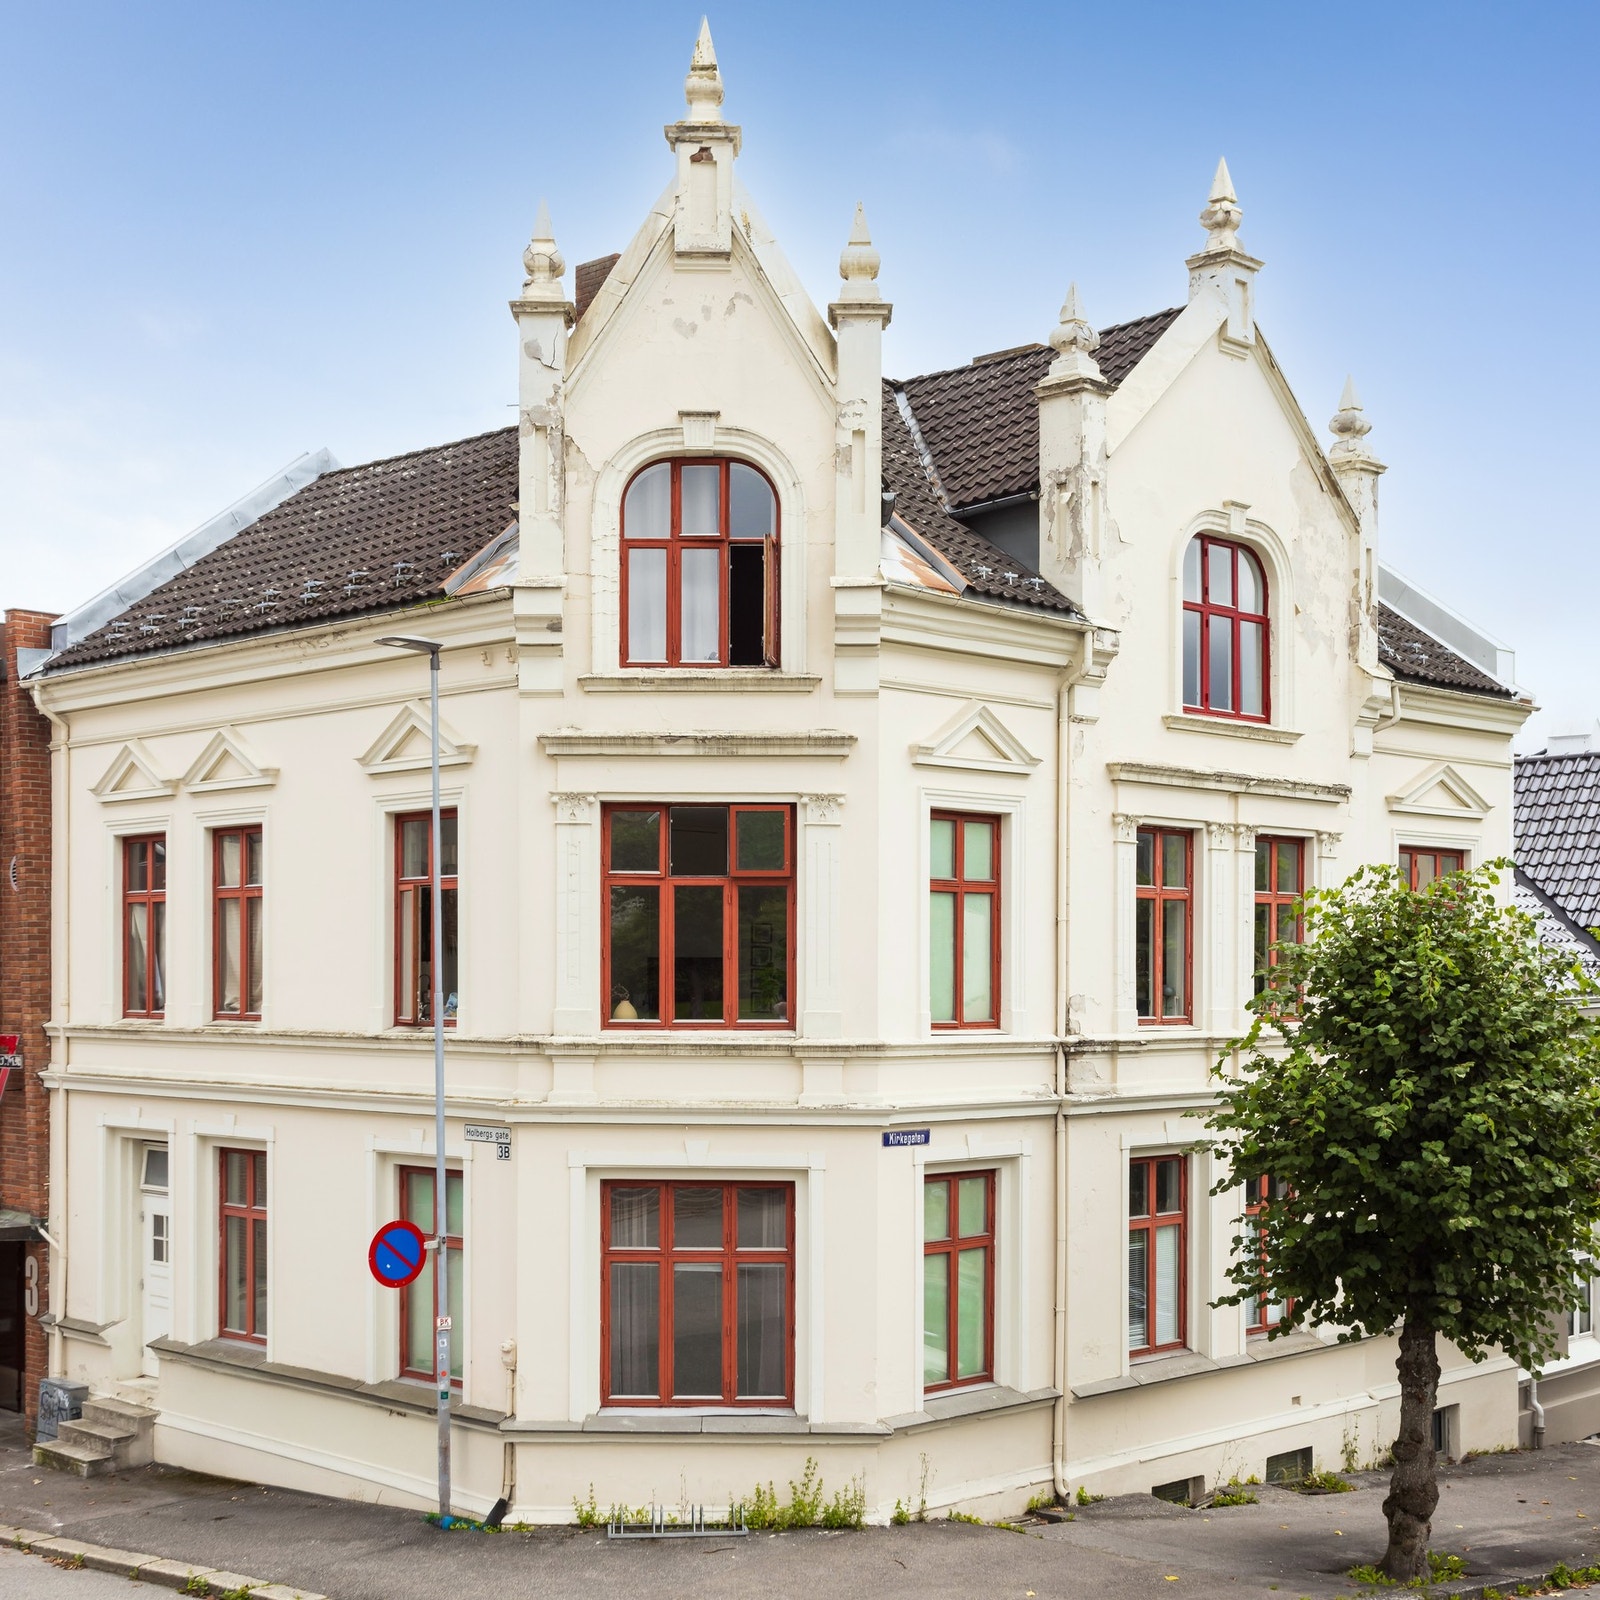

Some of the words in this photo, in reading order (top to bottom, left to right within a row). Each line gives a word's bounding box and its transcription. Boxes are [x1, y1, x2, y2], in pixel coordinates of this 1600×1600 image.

[466, 1128, 493, 1140] Holbergs
[495, 1131, 509, 1141] gate
[889, 1132, 926, 1146] Kirkegaten
[498, 1145, 510, 1159] 3B
[25, 1255, 39, 1317] 3
